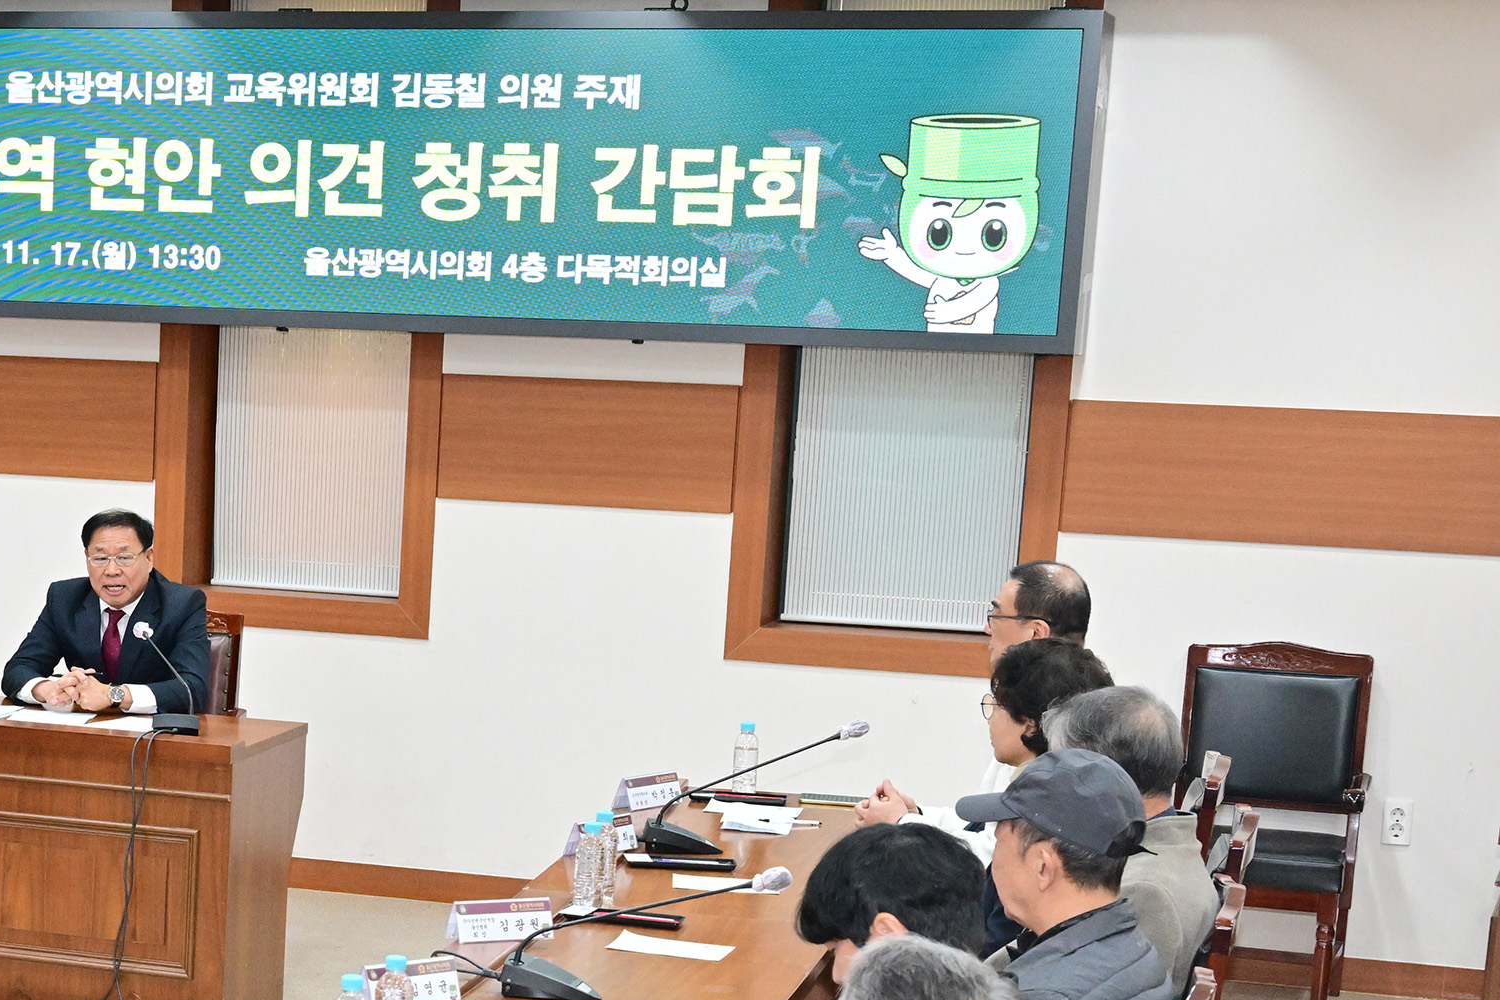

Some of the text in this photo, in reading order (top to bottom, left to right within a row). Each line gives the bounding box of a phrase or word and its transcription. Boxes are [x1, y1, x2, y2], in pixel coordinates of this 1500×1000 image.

[5, 70, 642, 110] 울산광역시의회 교육위원회 김동칠 의원 주재
[84, 137, 222, 214] 현안
[244, 139, 386, 218] 의견
[411, 141, 560, 224] 청취
[590, 144, 823, 230] 간담회
[2, 239, 40, 265] 11.
[51, 241, 138, 271] 17.(월)
[148, 243, 222, 271] 13:30
[303, 246, 728, 288] 울산광역시의회 4층 다목적회의실
[500, 917, 539, 932] 김광원
